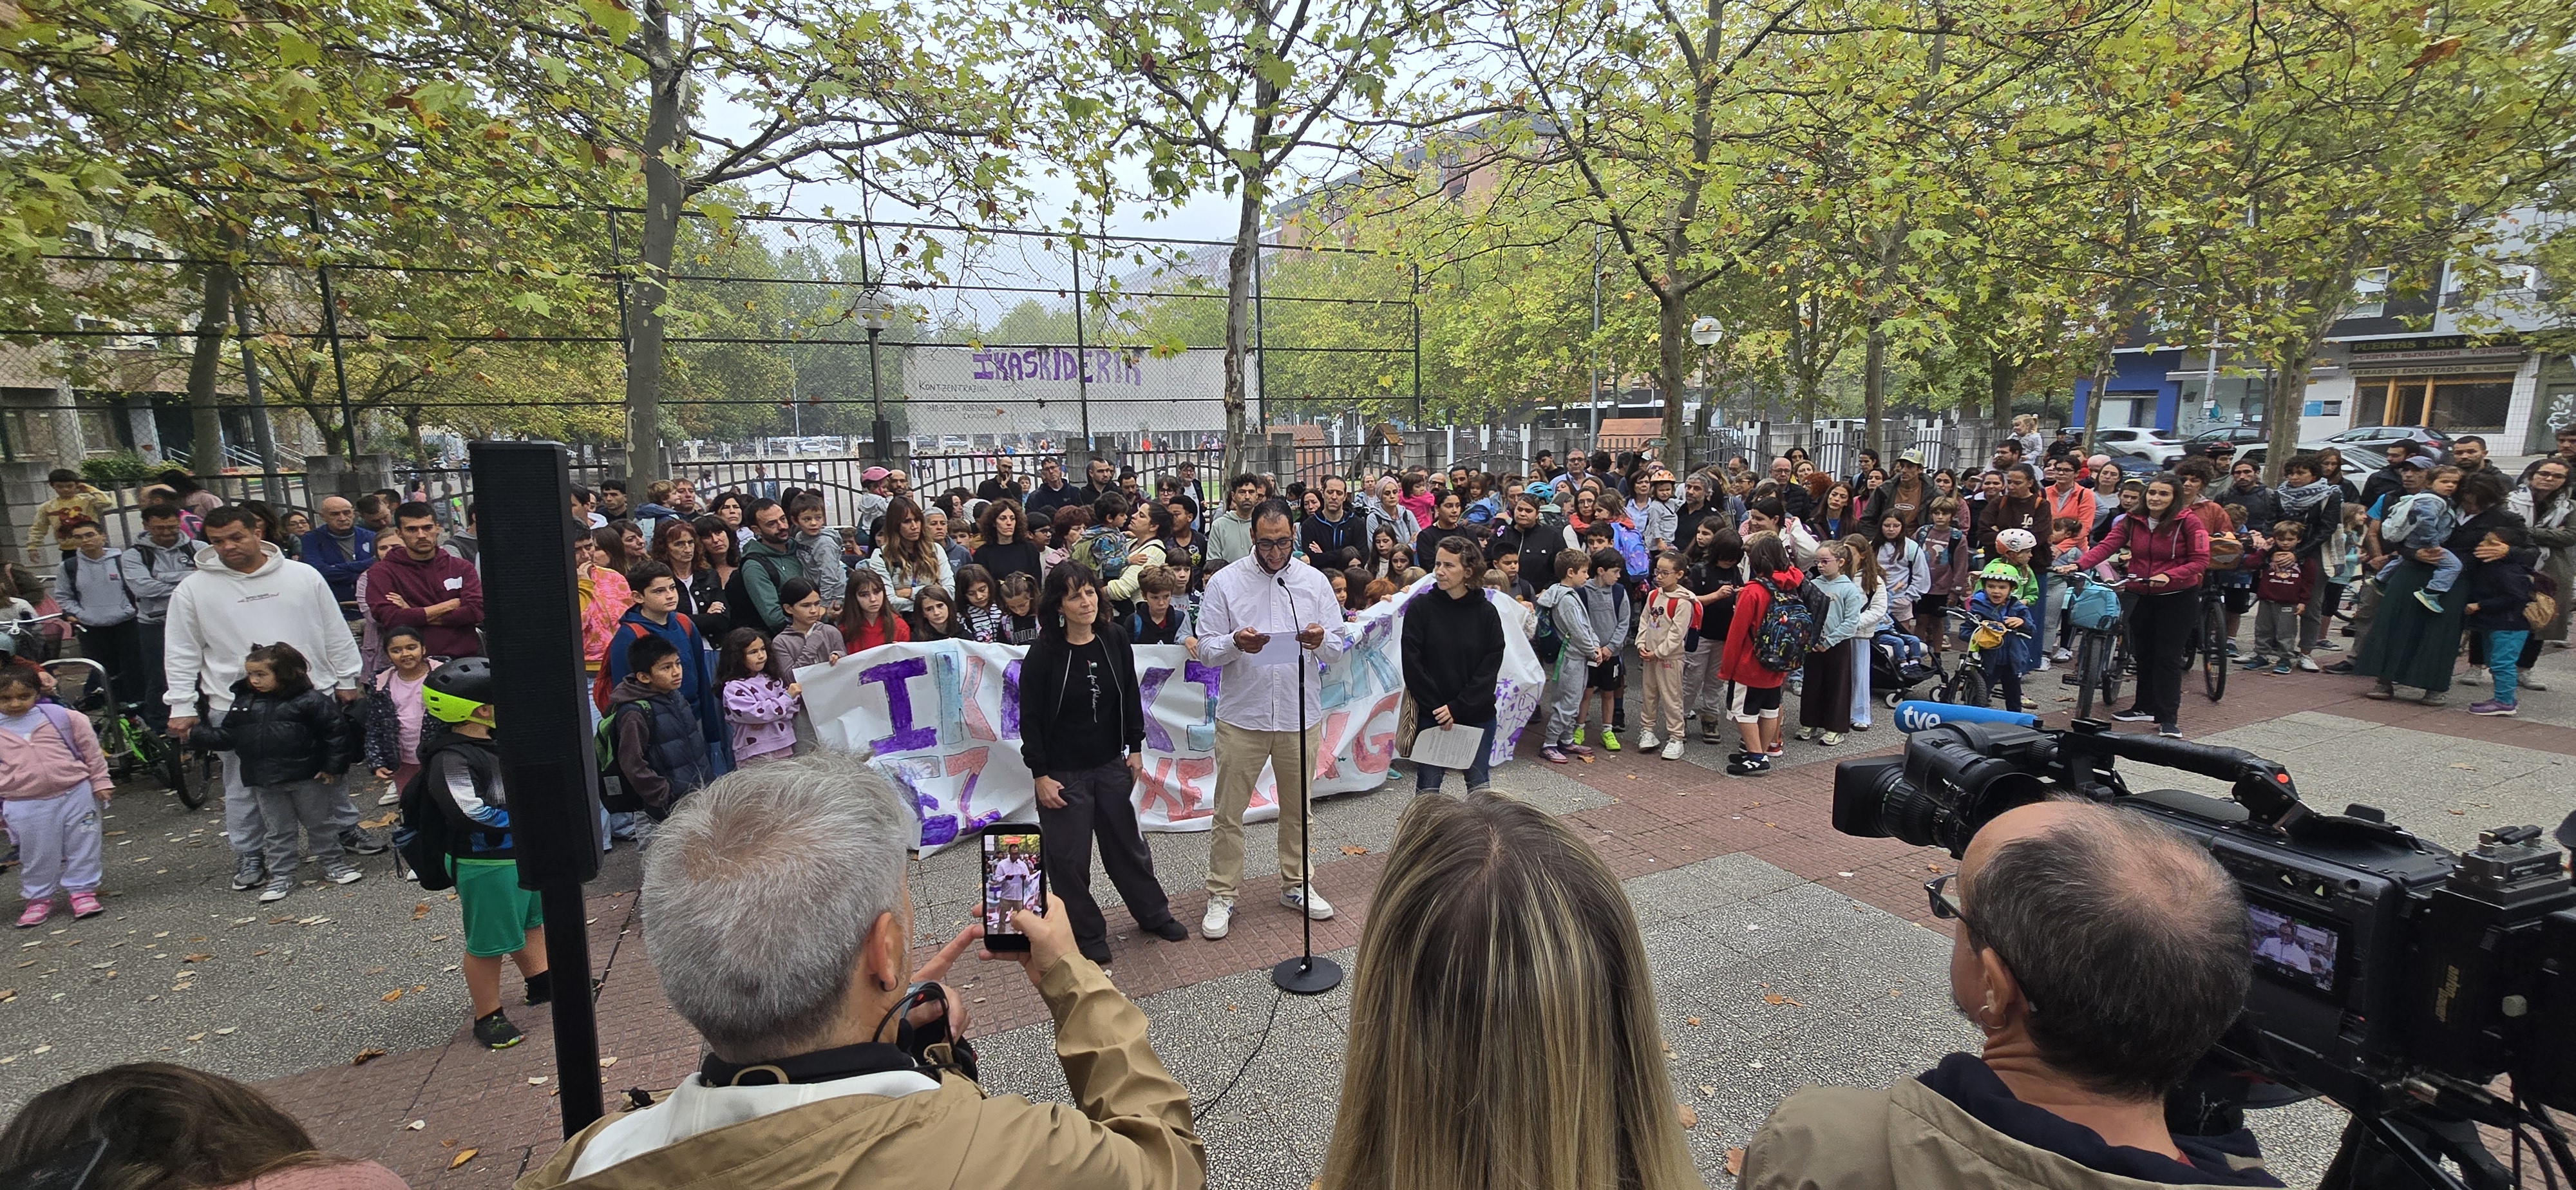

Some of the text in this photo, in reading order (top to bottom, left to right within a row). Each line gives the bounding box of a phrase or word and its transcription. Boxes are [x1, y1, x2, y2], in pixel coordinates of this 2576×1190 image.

[2353, 340, 2416, 351] PUERTAS
[2403, 366, 2467, 374] EMPOTRADOS
[1903, 705, 1942, 730] tve
